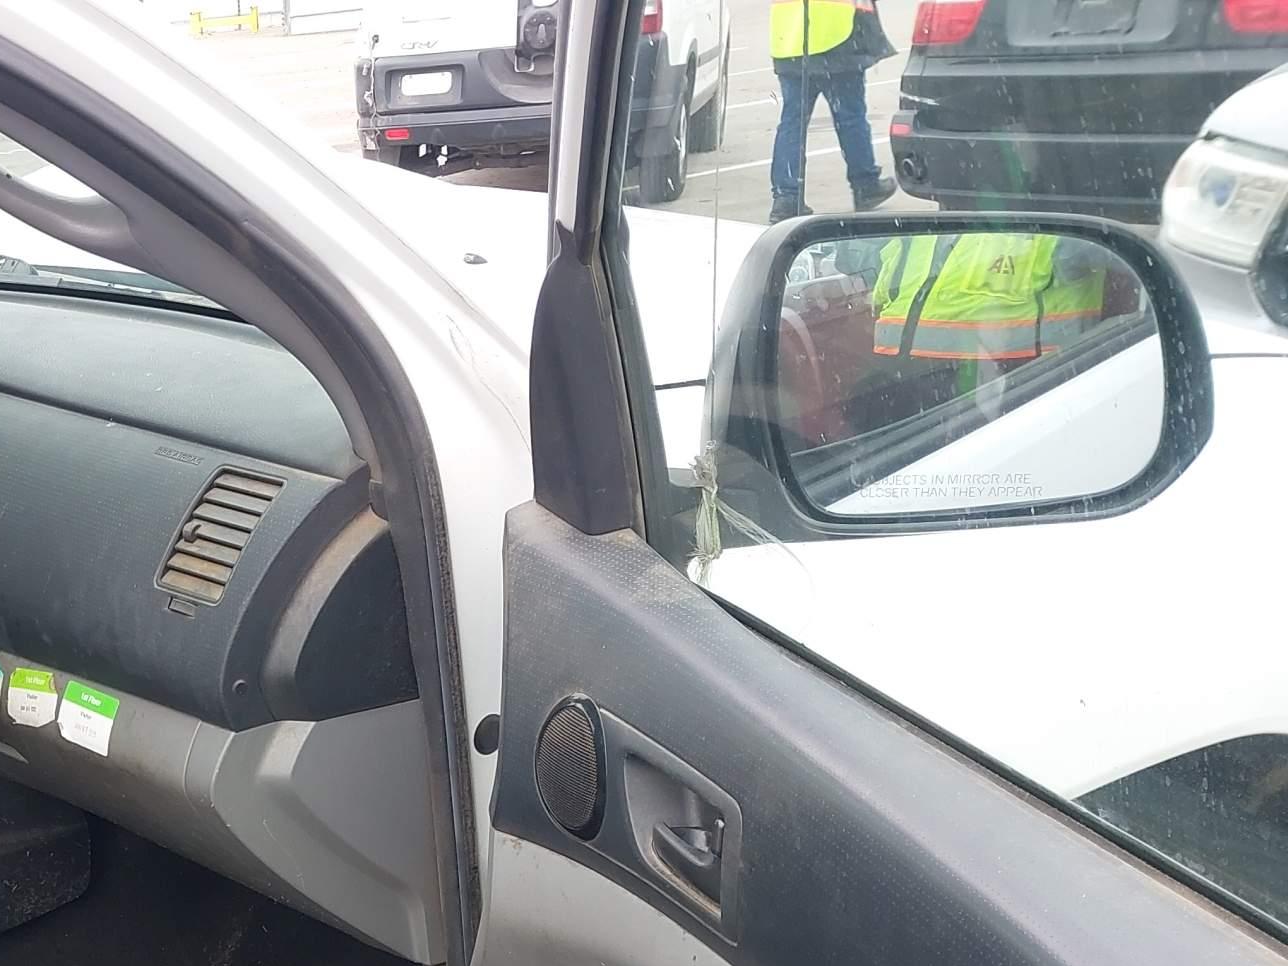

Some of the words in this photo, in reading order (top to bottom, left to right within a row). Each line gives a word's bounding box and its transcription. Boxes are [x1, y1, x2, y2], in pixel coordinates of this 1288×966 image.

[930, 473, 945, 486] IN
[947, 472, 1001, 486] MIRROR
[1004, 472, 1033, 485] ARE
[859, 486, 910, 499] CLOSER
[911, 486, 948, 498] THAN
[951, 486, 985, 498] THEY
[987, 485, 1043, 498] APPEAR
